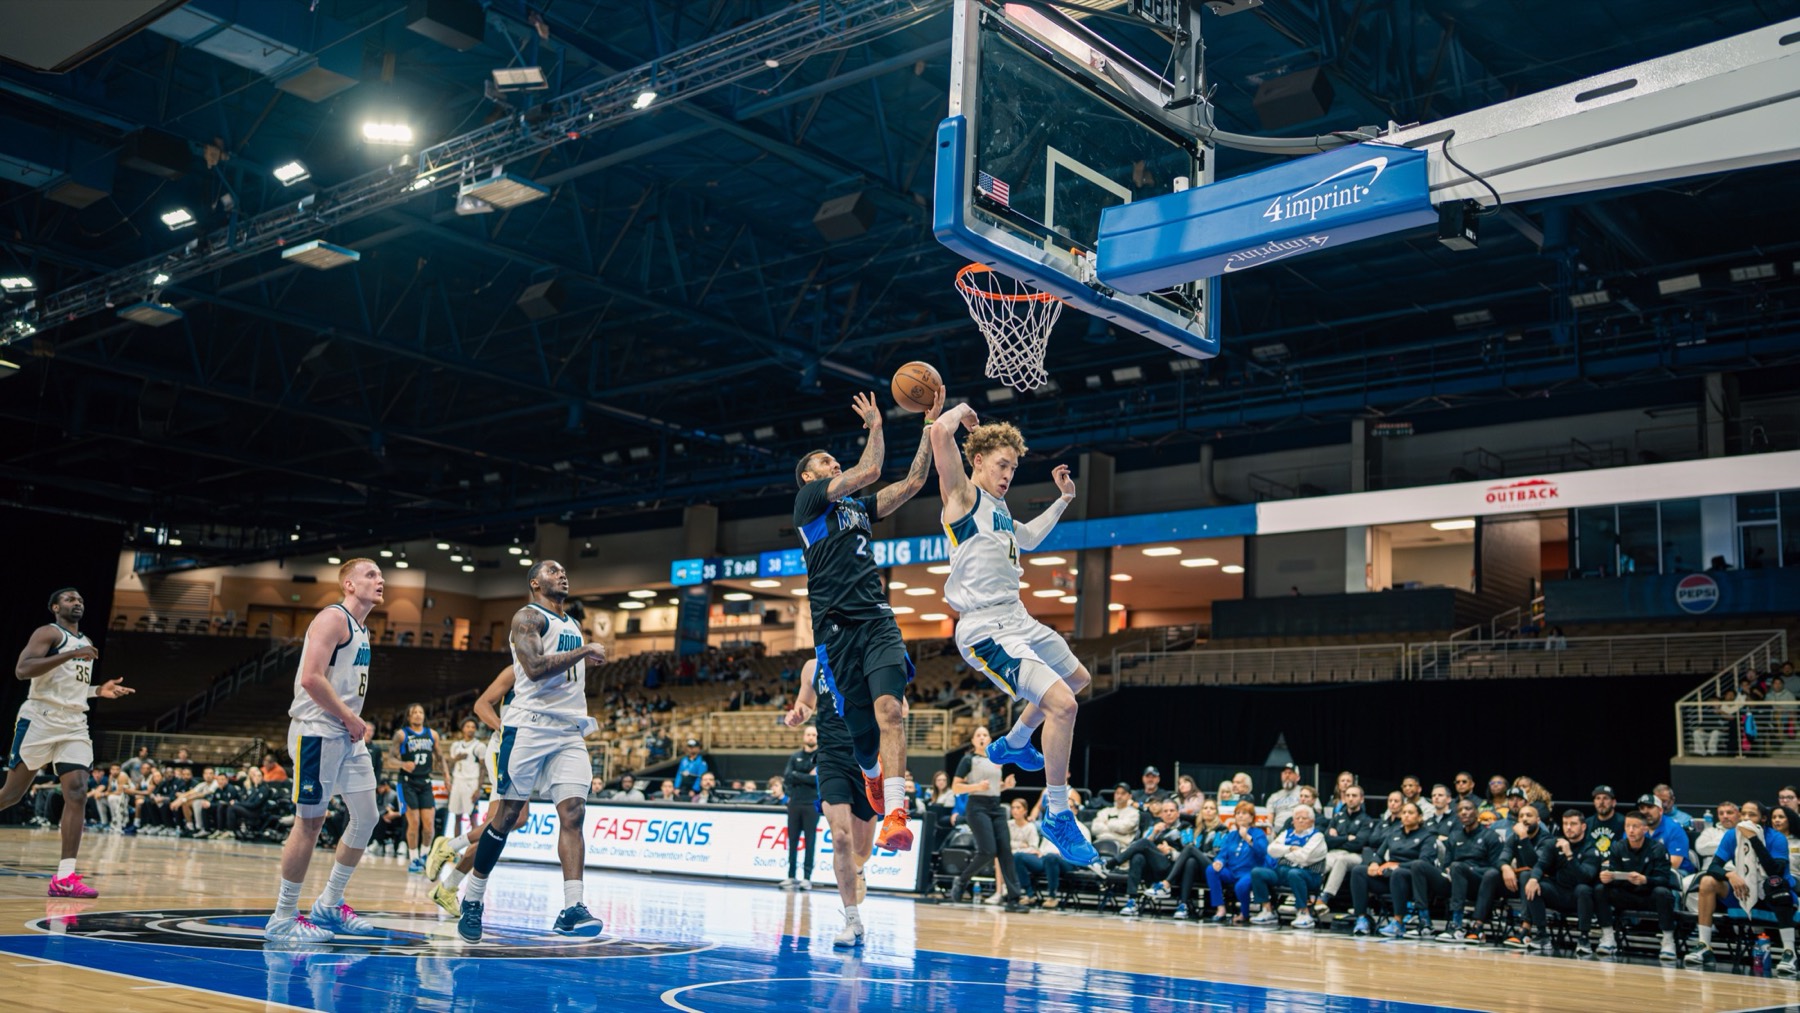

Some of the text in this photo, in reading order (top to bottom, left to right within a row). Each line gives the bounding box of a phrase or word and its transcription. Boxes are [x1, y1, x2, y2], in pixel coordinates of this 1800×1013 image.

[1263, 184, 1362, 223] 4imprint
[1235, 235, 1329, 263] 4imprint
[1485, 486, 1559, 503] OUTBACK
[856, 535, 867, 556] 2
[873, 540, 911, 565] BIG
[1009, 537, 1018, 565] 4
[703, 564, 716, 579] 35
[1679, 588, 1716, 598] PEPSI
[76, 664, 90, 684] 35
[358, 673, 367, 697] 6
[414, 753, 428, 765] 13
[593, 817, 713, 846] FASTSIGNS
[588, 845, 608, 855] South
[685, 852, 711, 863] Center
